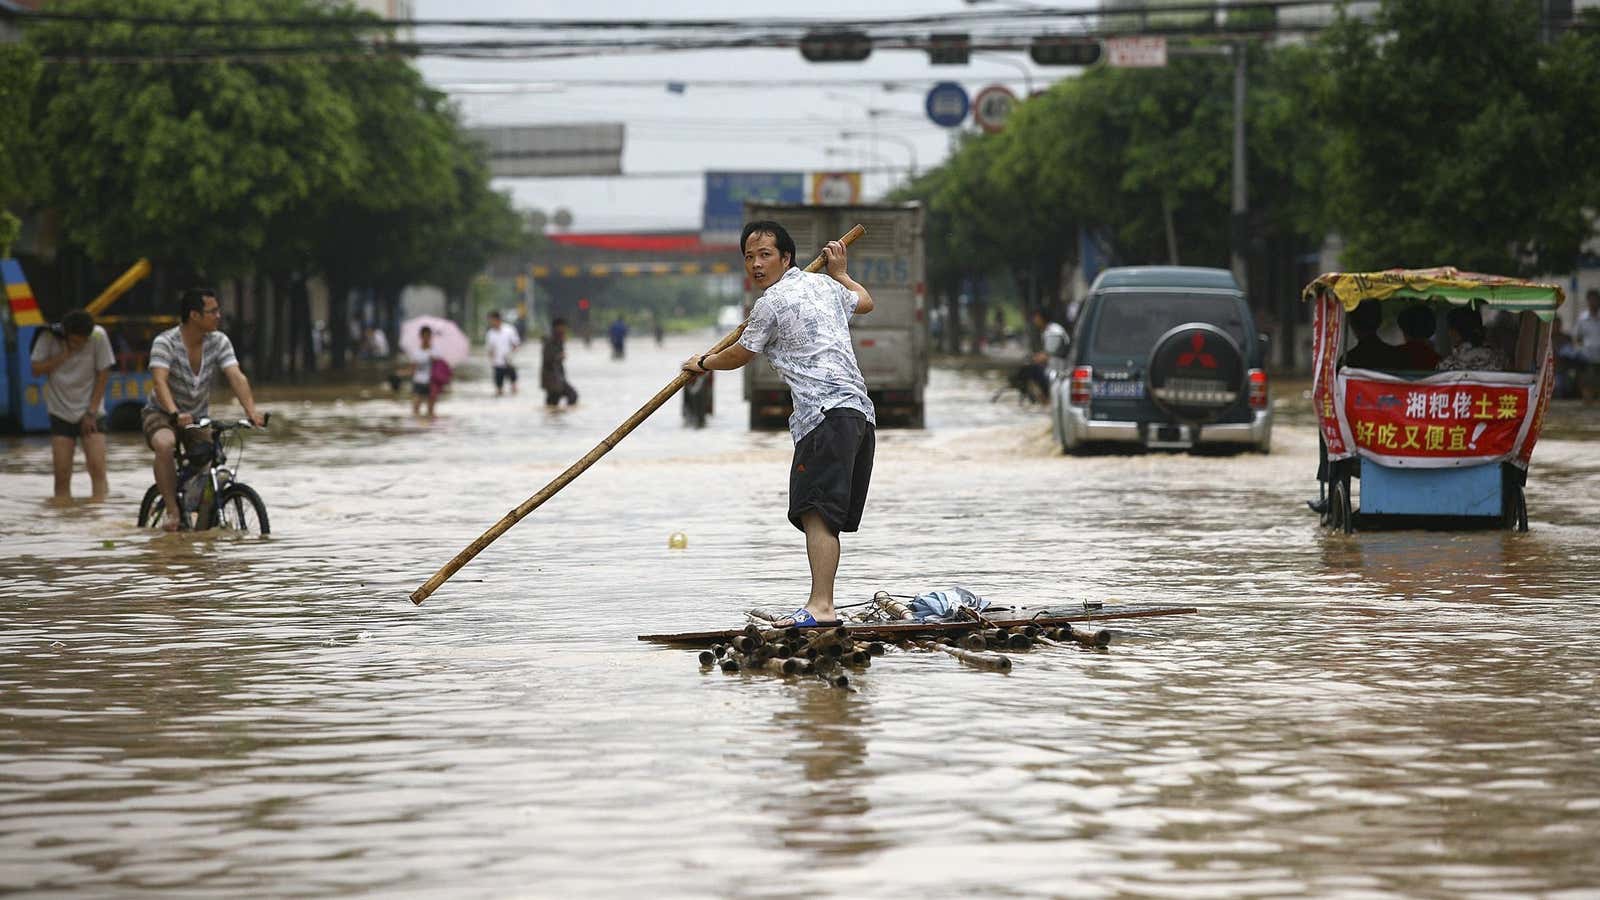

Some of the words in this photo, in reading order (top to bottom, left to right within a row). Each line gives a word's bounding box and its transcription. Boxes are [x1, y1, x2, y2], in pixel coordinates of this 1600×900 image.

[1356, 420, 1487, 450] 好吃又便宜!
